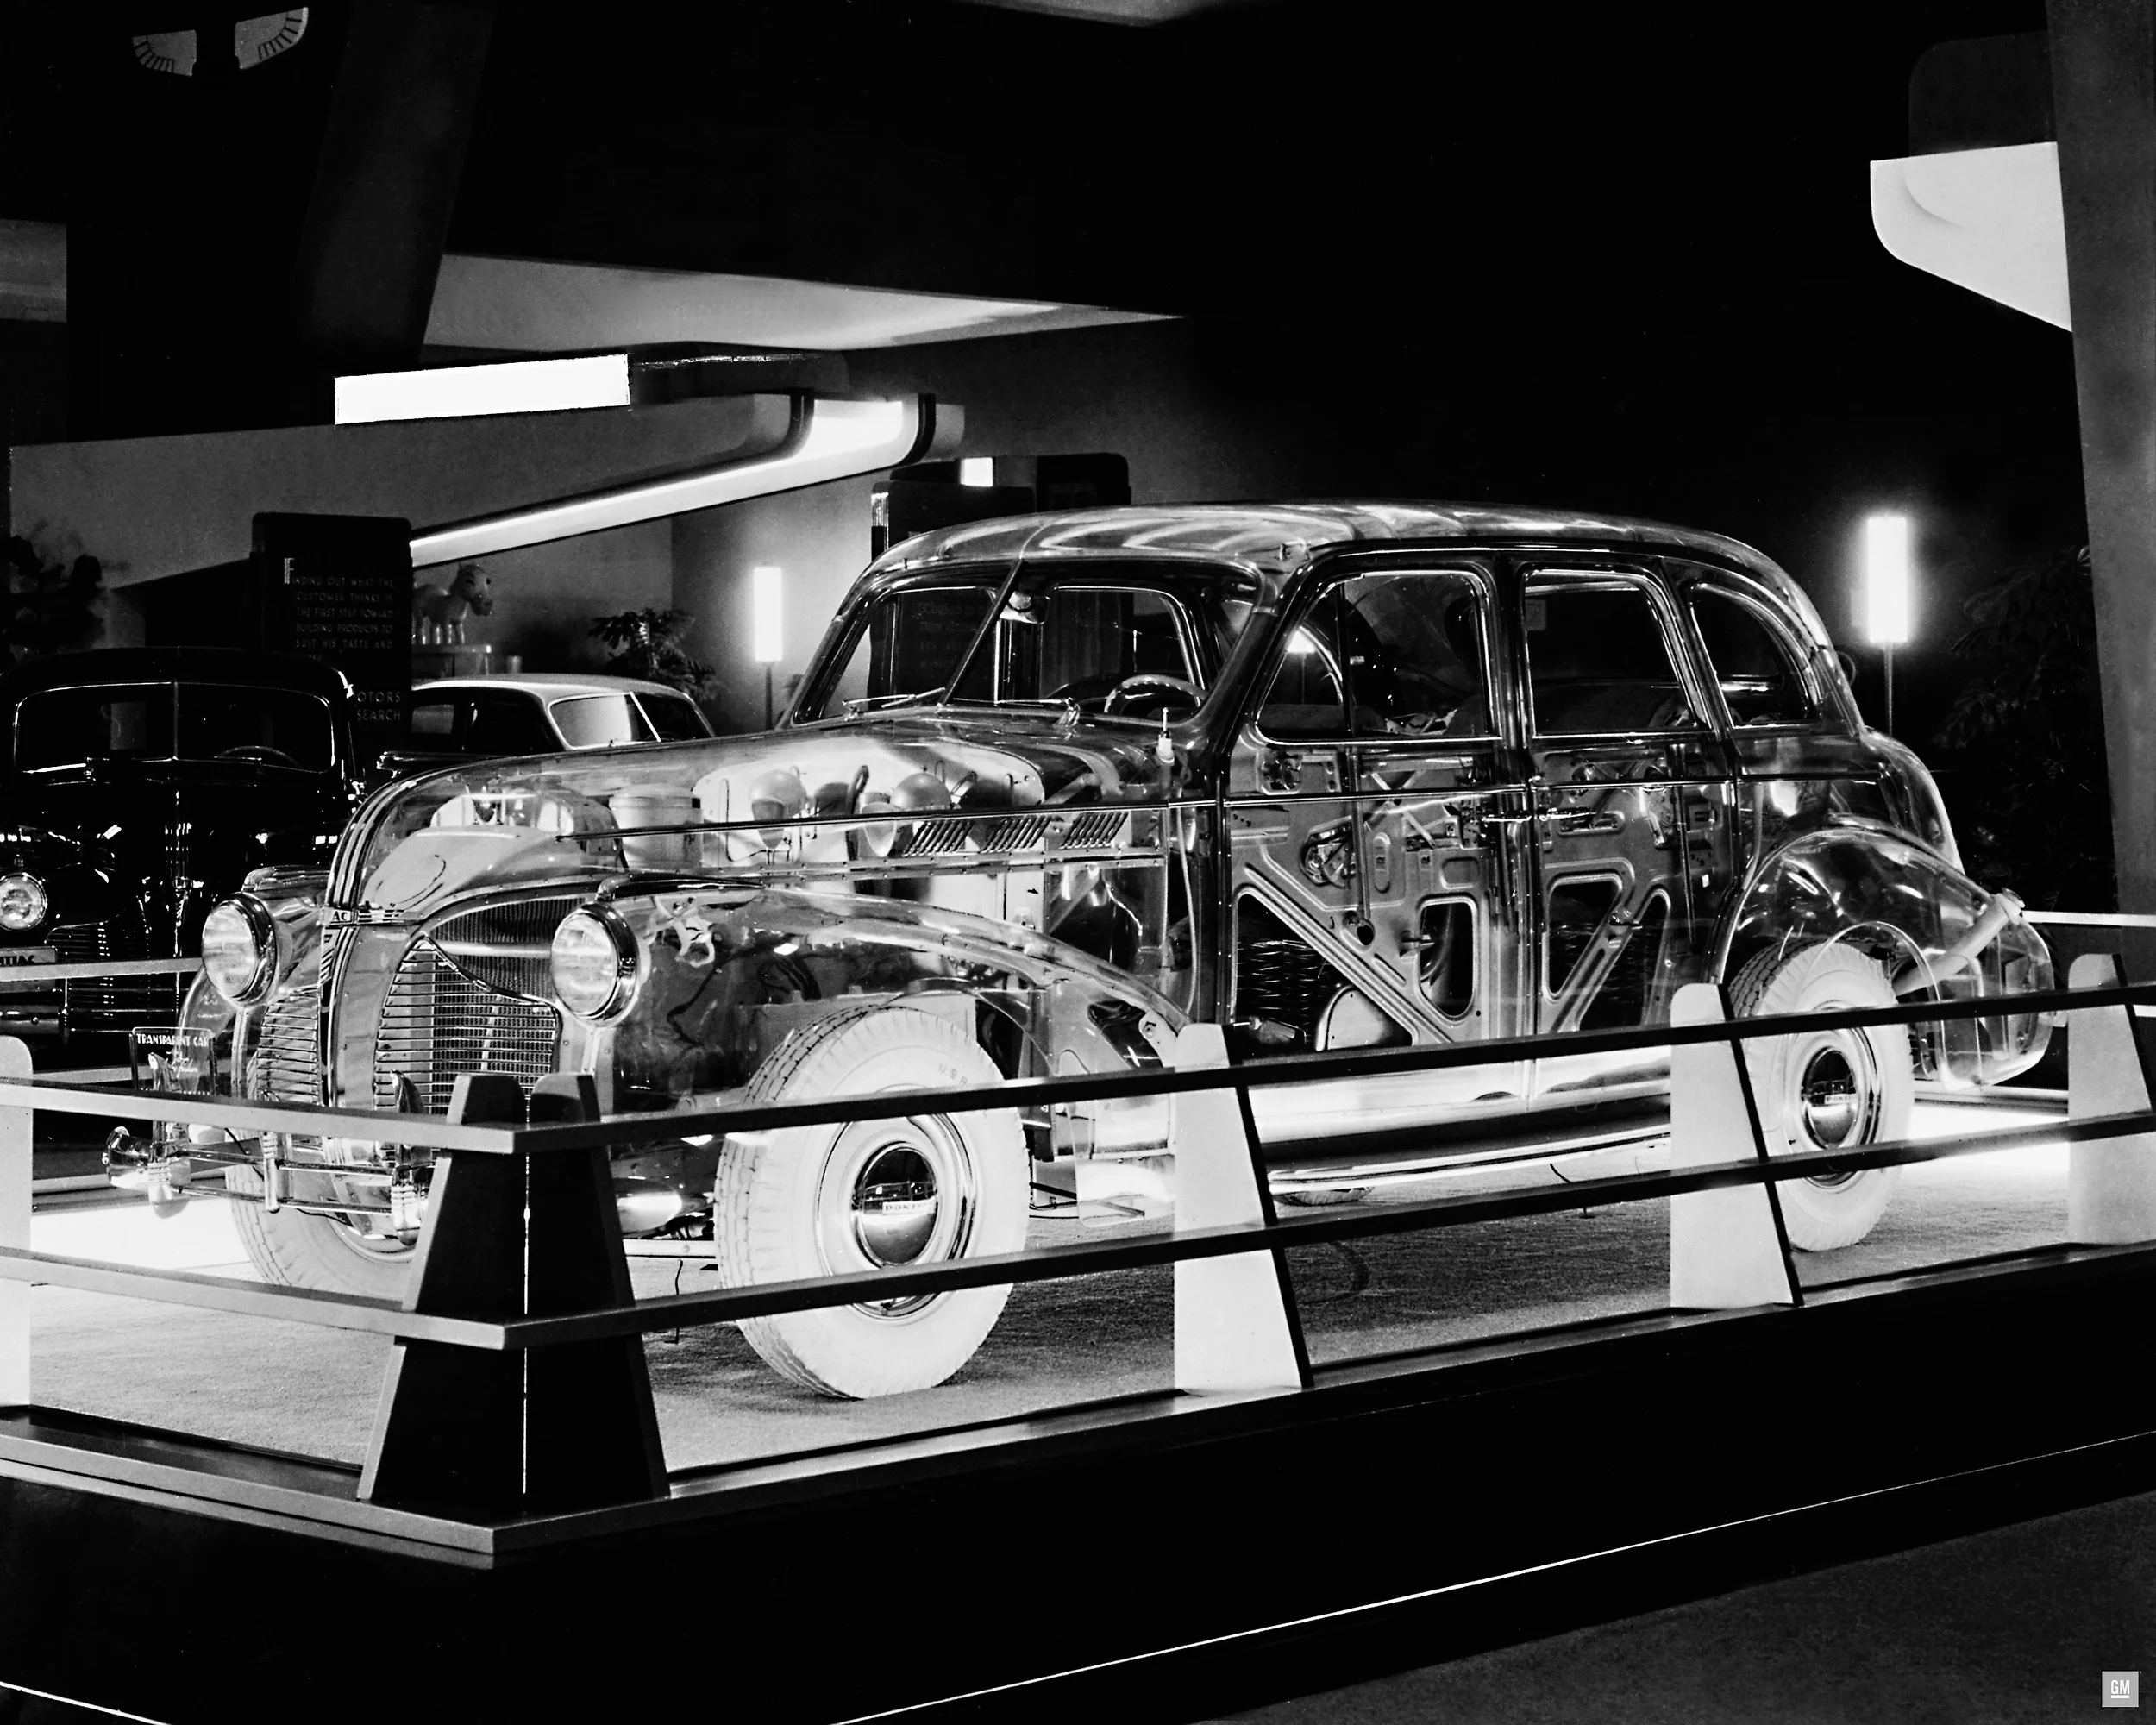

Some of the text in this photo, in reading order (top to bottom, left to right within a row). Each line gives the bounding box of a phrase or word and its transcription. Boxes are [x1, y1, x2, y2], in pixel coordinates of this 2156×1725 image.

[284, 557, 394, 588] FINDING OUT WHAT THE
[297, 591, 394, 603] CUSTOMER THINKS IS
[297, 607, 393, 618] THE FIRST STEP TOWARD
[296, 623, 393, 634] BUILDING PRODUCTS TO
[296, 638, 392, 649] SUIT HIS TASTE AND
[356, 691, 401, 703] OTORS
[355, 708, 401, 721] SEARCH
[192, 1036, 209, 1047] CAR
